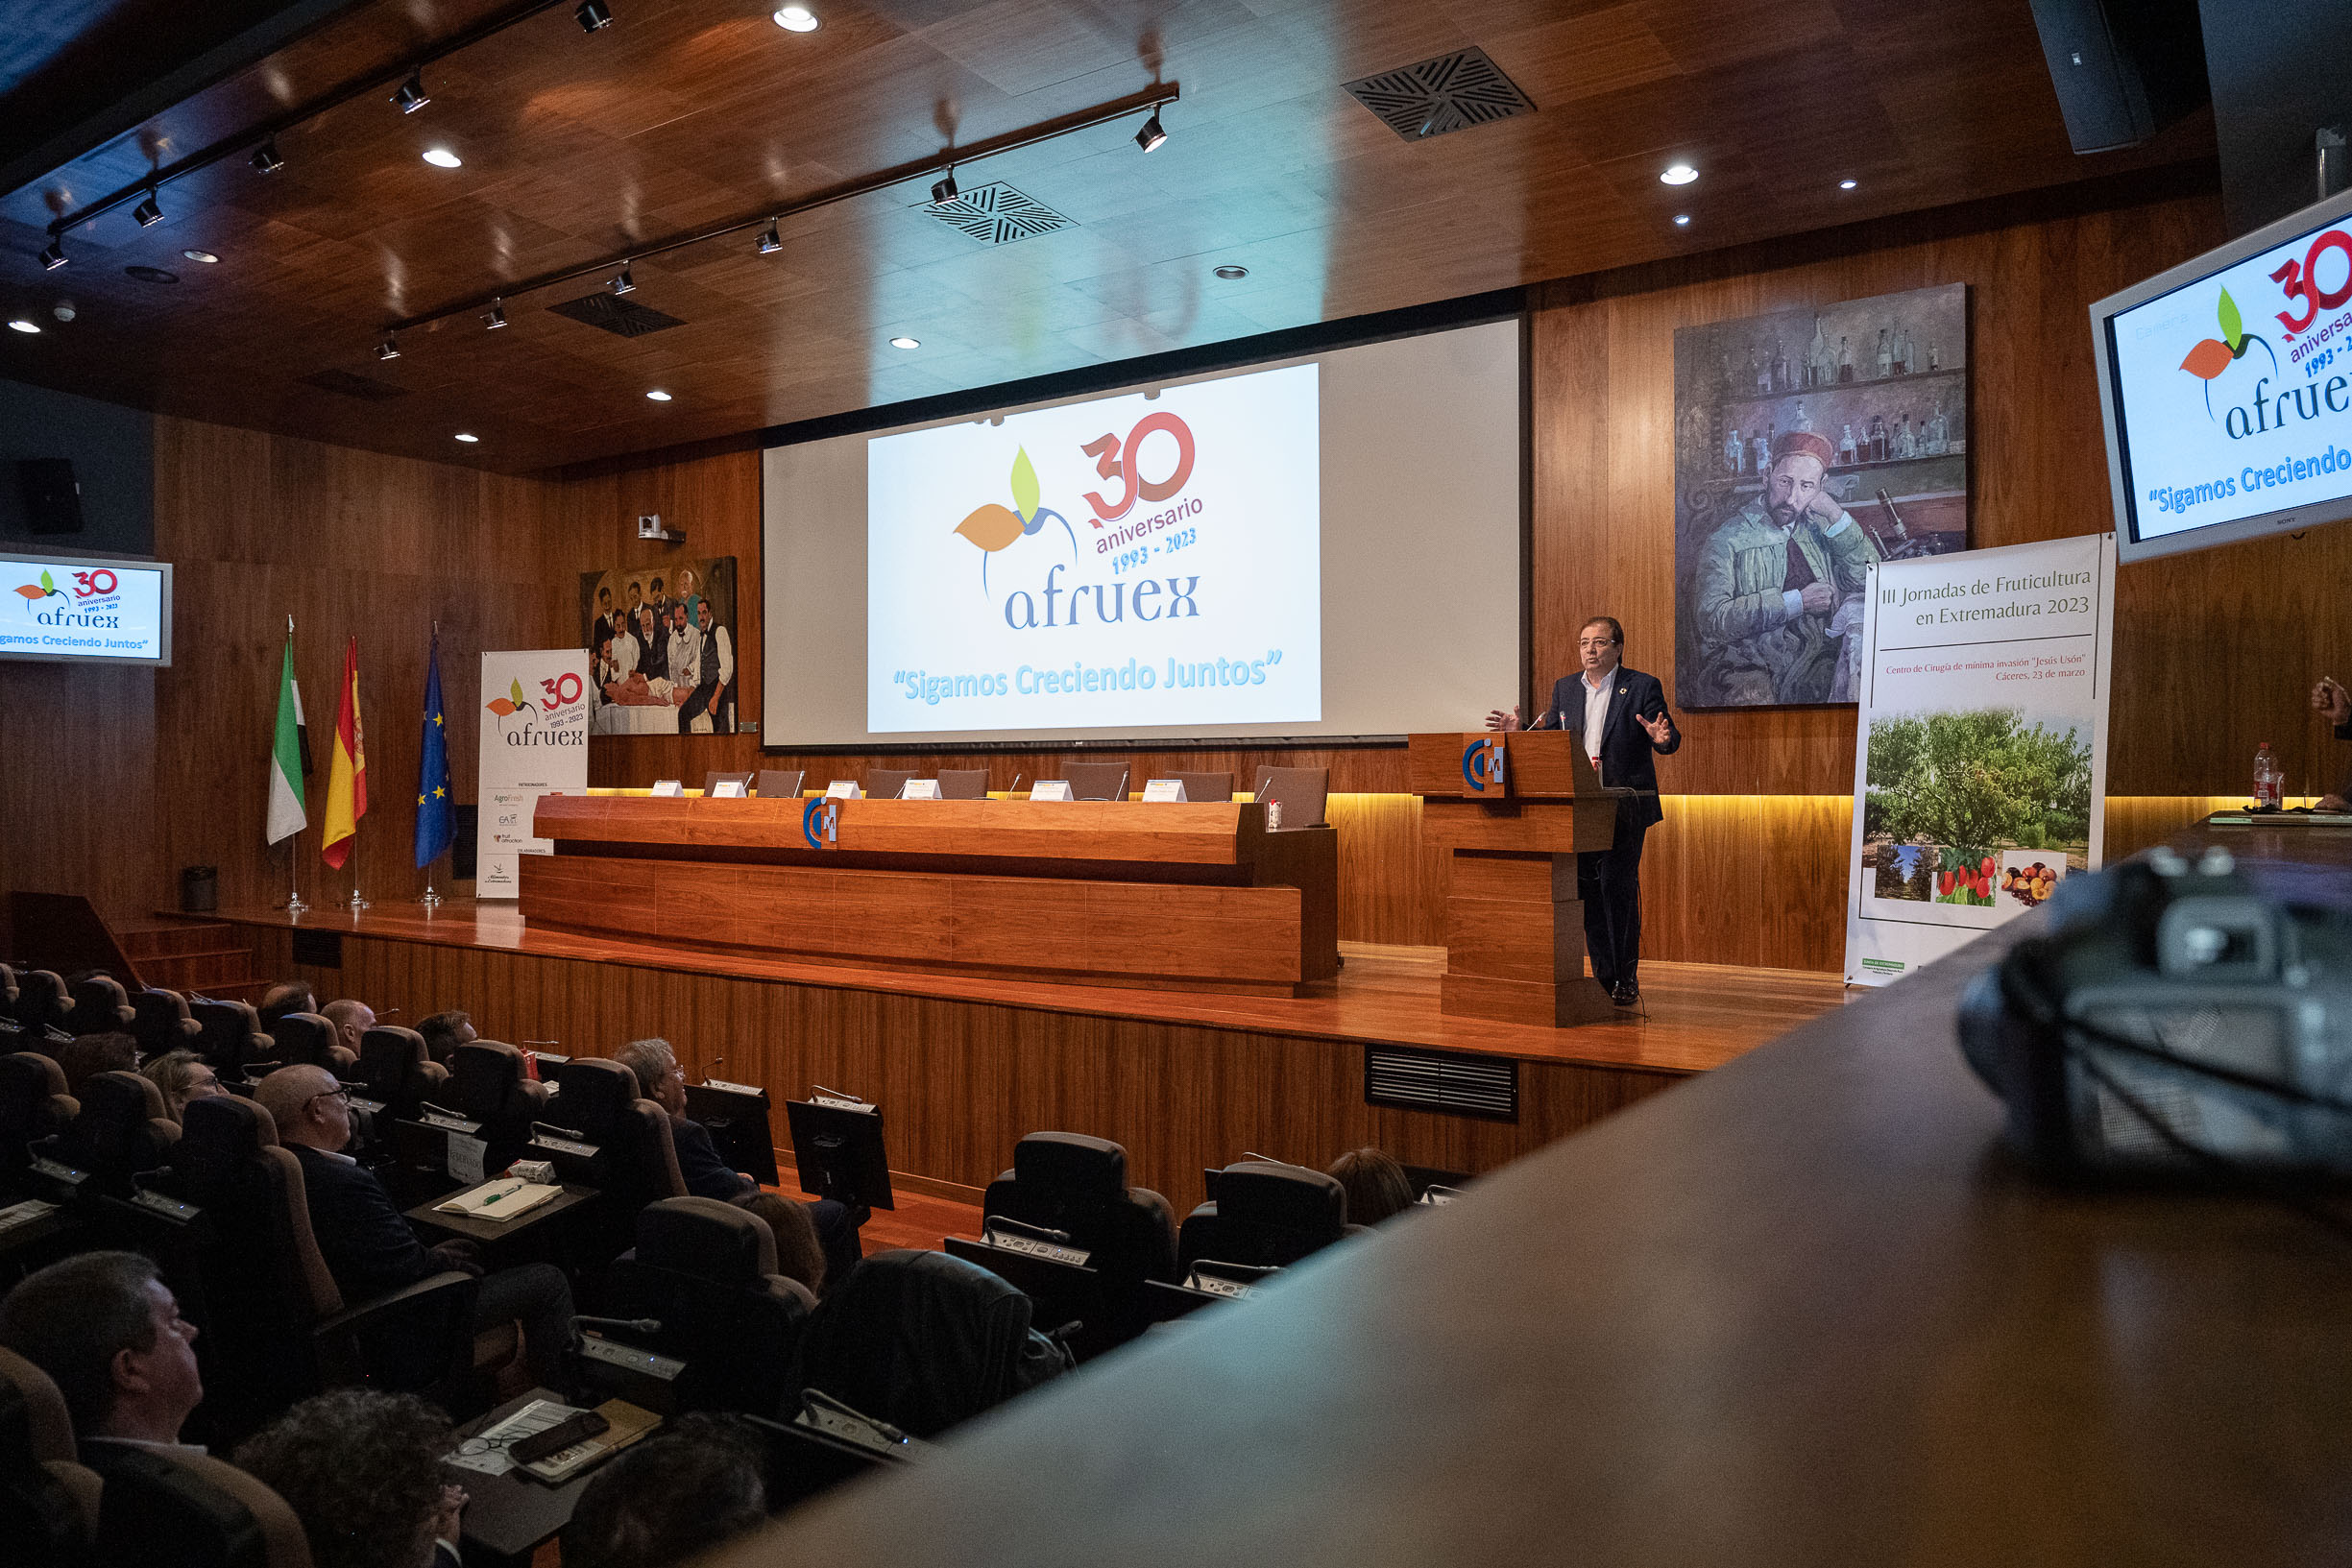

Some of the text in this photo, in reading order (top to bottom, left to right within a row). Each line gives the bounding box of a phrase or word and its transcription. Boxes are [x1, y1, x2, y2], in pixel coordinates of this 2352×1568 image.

[2305, 348, 2334, 378] 1993
[2225, 373, 2352, 440] afrue
[1079, 411, 1196, 529] 30
[2241, 446, 2352, 493] Creciendo
[1096, 498, 1203, 553] aniversario
[1112, 545, 1149, 575] 1993
[1166, 527, 1197, 554] 2023
[71, 568, 118, 599] 30
[1005, 564, 1201, 630] afruex
[1882, 569, 2091, 608] III Jornadas de Fruticultura
[78, 593, 121, 607] aniversario
[1916, 596, 2090, 626] en Extremadura 2023
[37, 606, 119, 629] afruex
[42, 635, 102, 648] Creciendo
[893, 669, 1007, 706] “Sigamos
[1015, 658, 1156, 696] Creciendo
[1885, 665, 1912, 675] Centro
[1913, 664, 1923, 673] de
[1924, 663, 1952, 674] Cirugía
[1952, 662, 1963, 671] de
[1997, 659, 2029, 668] invasión
[1996, 668, 2086, 681] Cáceres, 23 de marzo
[540, 672, 583, 712] 30
[546, 703, 586, 721] aniversario
[550, 719, 564, 729] 1993
[569, 713, 583, 724] 2023
[507, 722, 583, 747] afruex
